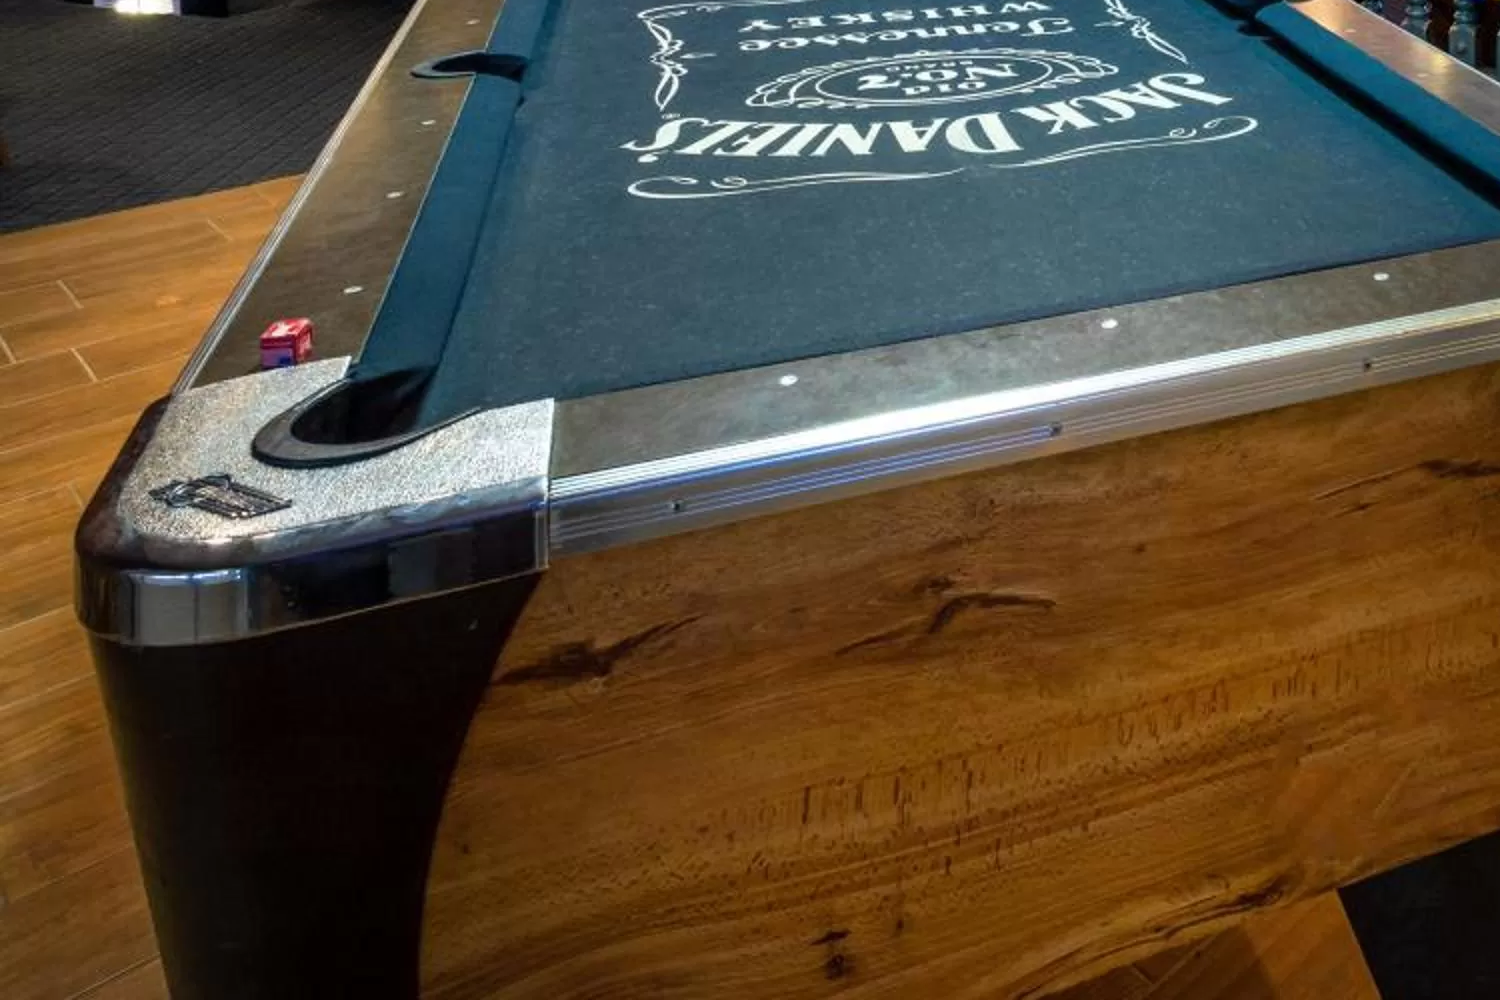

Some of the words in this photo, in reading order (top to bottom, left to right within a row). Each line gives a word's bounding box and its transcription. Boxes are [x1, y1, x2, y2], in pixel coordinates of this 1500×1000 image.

[738, 0, 1052, 33] WHISKEY
[738, 17, 1075, 51] Tennessee
[1015, 71, 1234, 137] JACK
